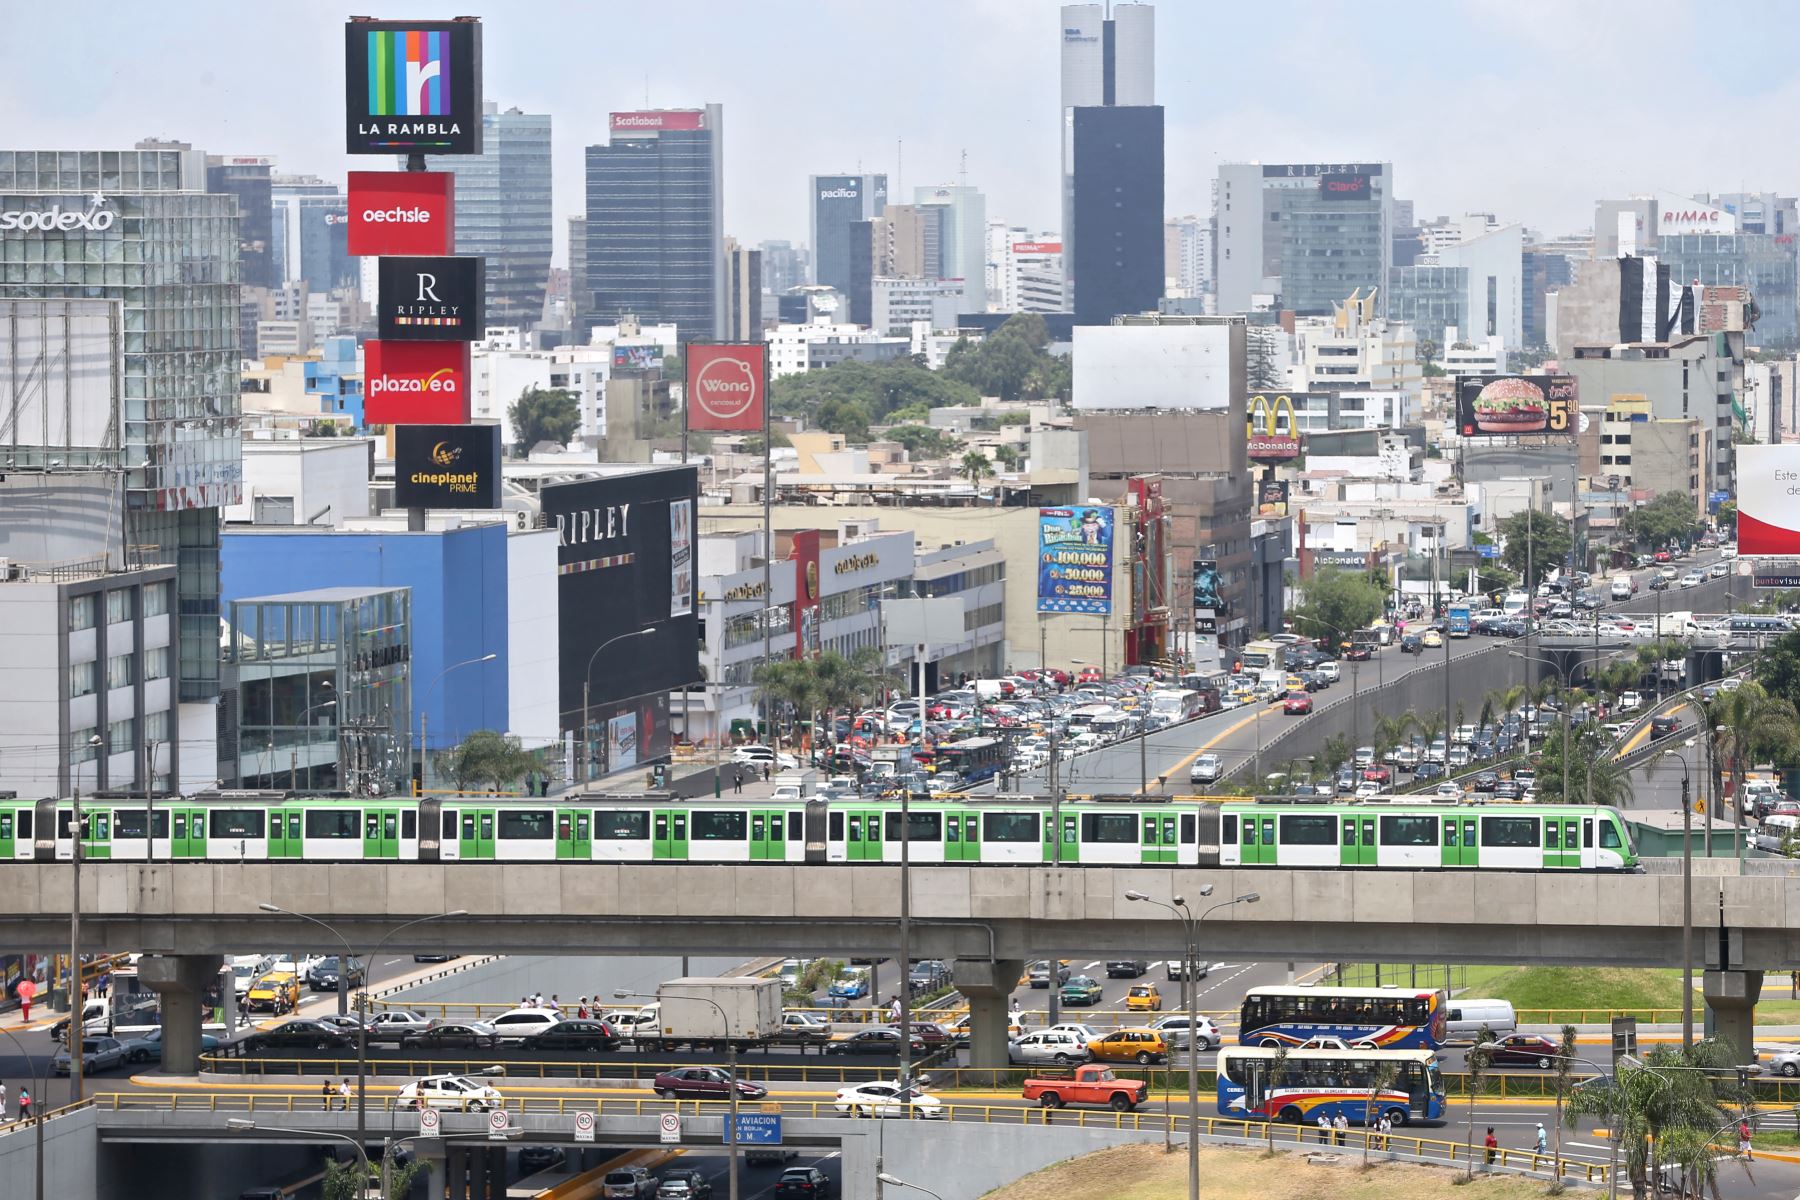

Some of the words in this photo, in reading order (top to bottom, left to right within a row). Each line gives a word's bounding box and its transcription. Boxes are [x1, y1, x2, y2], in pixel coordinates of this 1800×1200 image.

[359, 123, 380, 135] LA
[387, 123, 461, 135] RAMBLA
[1328, 181, 1358, 191] Claro
[0, 203, 114, 231] sodexo
[363, 206, 430, 223] oechsle
[1663, 210, 1719, 222] RIMAC
[416, 273, 442, 302] R
[398, 305, 458, 315] RIPLEY
[370, 368, 456, 397] plazavea
[703, 379, 749, 393] Wong
[1550, 400, 1568, 430] 5
[1567, 399, 1578, 412] 90
[411, 471, 478, 486] cineplanet
[1774, 469, 1798, 481] Este
[449, 483, 477, 493] PRIME
[555, 503, 629, 547] RIPLEY
[1314, 556, 1366, 565] McDonald's
[494, 1115, 505, 1123] 80
[579, 1117, 591, 1125] 80
[664, 1118, 676, 1126] 80
[741, 1116, 777, 1125] AVIACION
[746, 1132, 753, 1140] M
